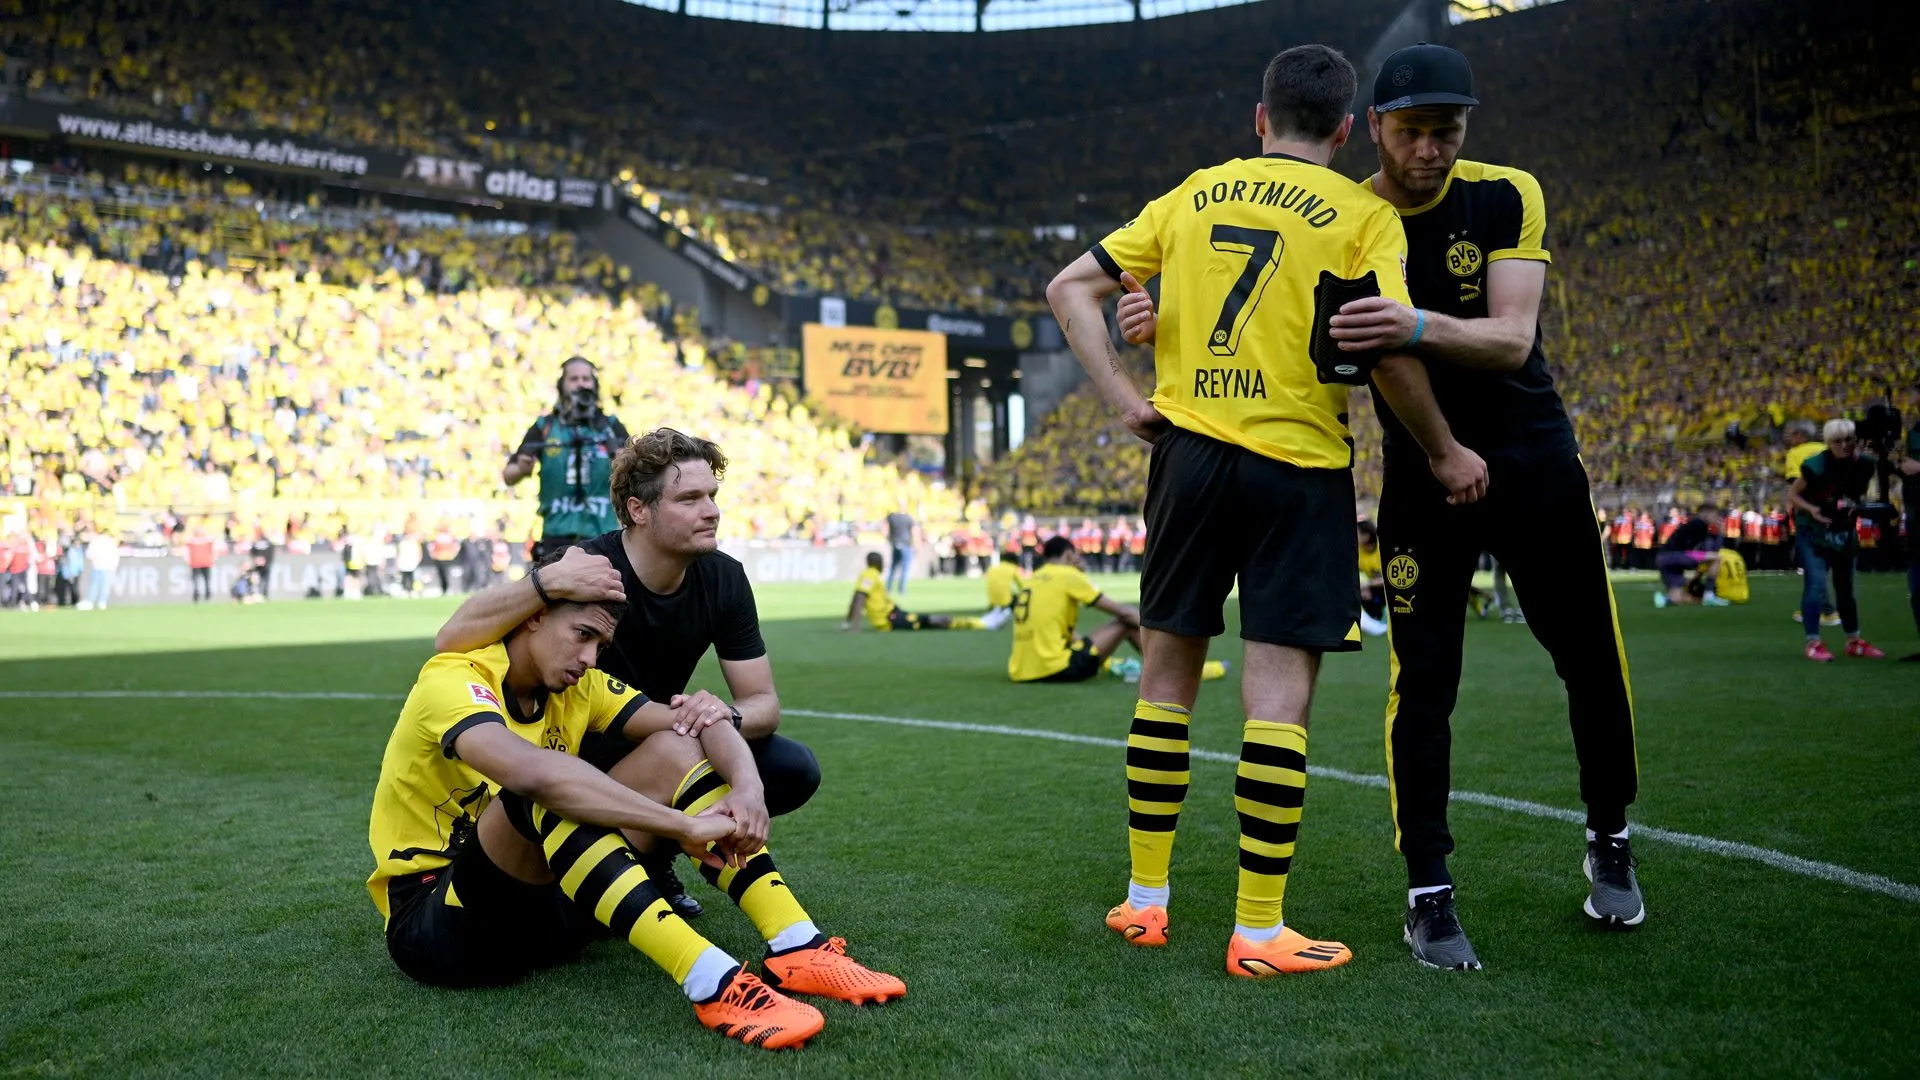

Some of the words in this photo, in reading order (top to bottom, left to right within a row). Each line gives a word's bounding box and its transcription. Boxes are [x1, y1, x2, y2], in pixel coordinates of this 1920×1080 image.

[57, 113, 368, 176] www.atlasschuhe.de/karriere
[485, 168, 556, 202] atlas
[1193, 180, 1338, 229] DORTMUND
[1449, 244, 1478, 269] BVB
[1208, 224, 1285, 356] 7
[1194, 368, 1267, 399] REYNA
[1391, 558, 1415, 579] BVB
